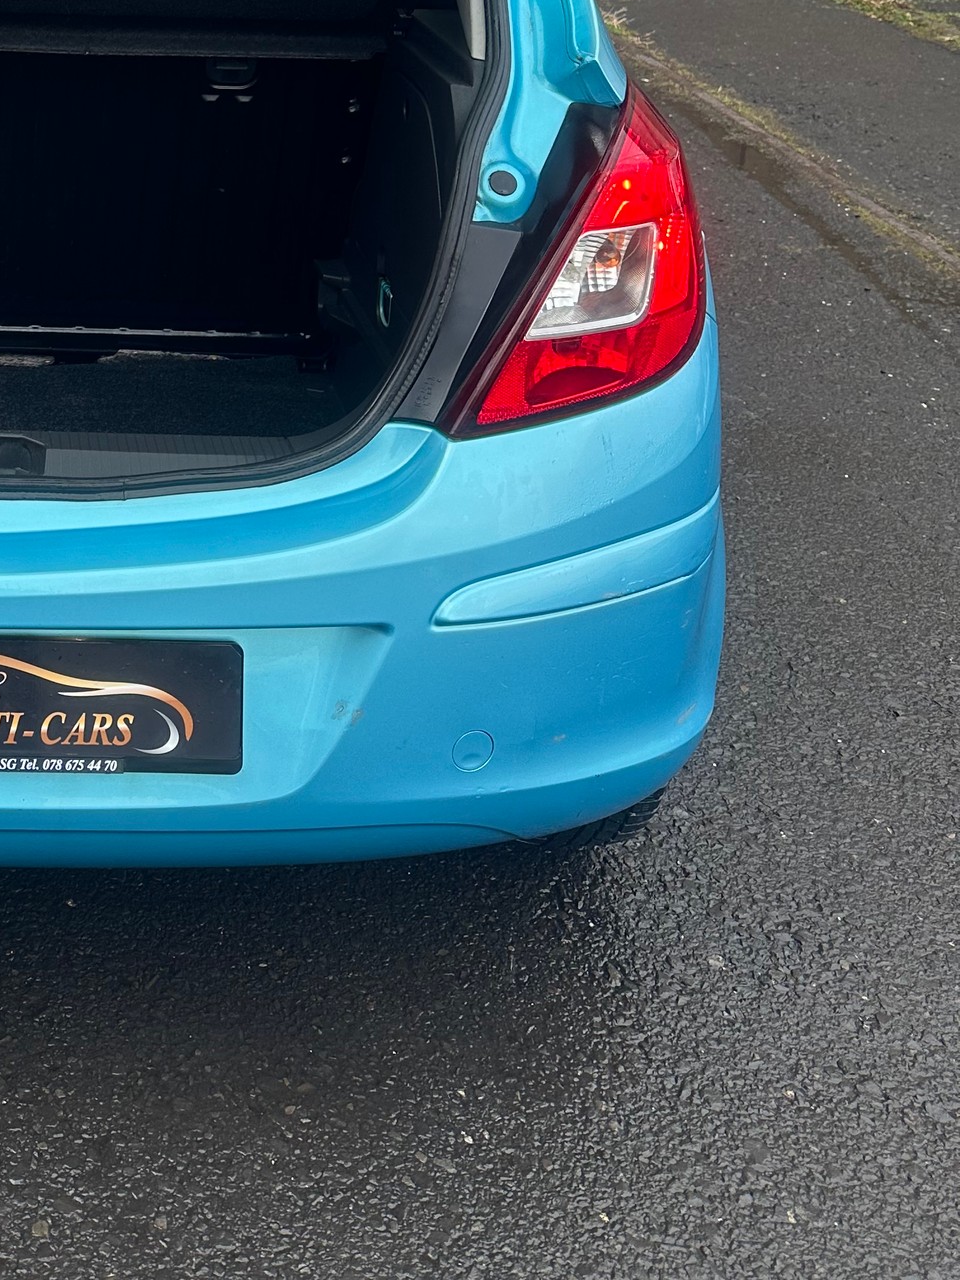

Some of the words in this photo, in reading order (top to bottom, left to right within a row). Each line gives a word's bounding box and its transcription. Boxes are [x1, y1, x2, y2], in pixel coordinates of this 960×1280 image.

[20, 758, 39, 771] Tel.
[43, 759, 64, 771] 078
[65, 759, 84, 771] 675
[87, 760, 102, 771] 44
[104, 760, 118, 772] 70
